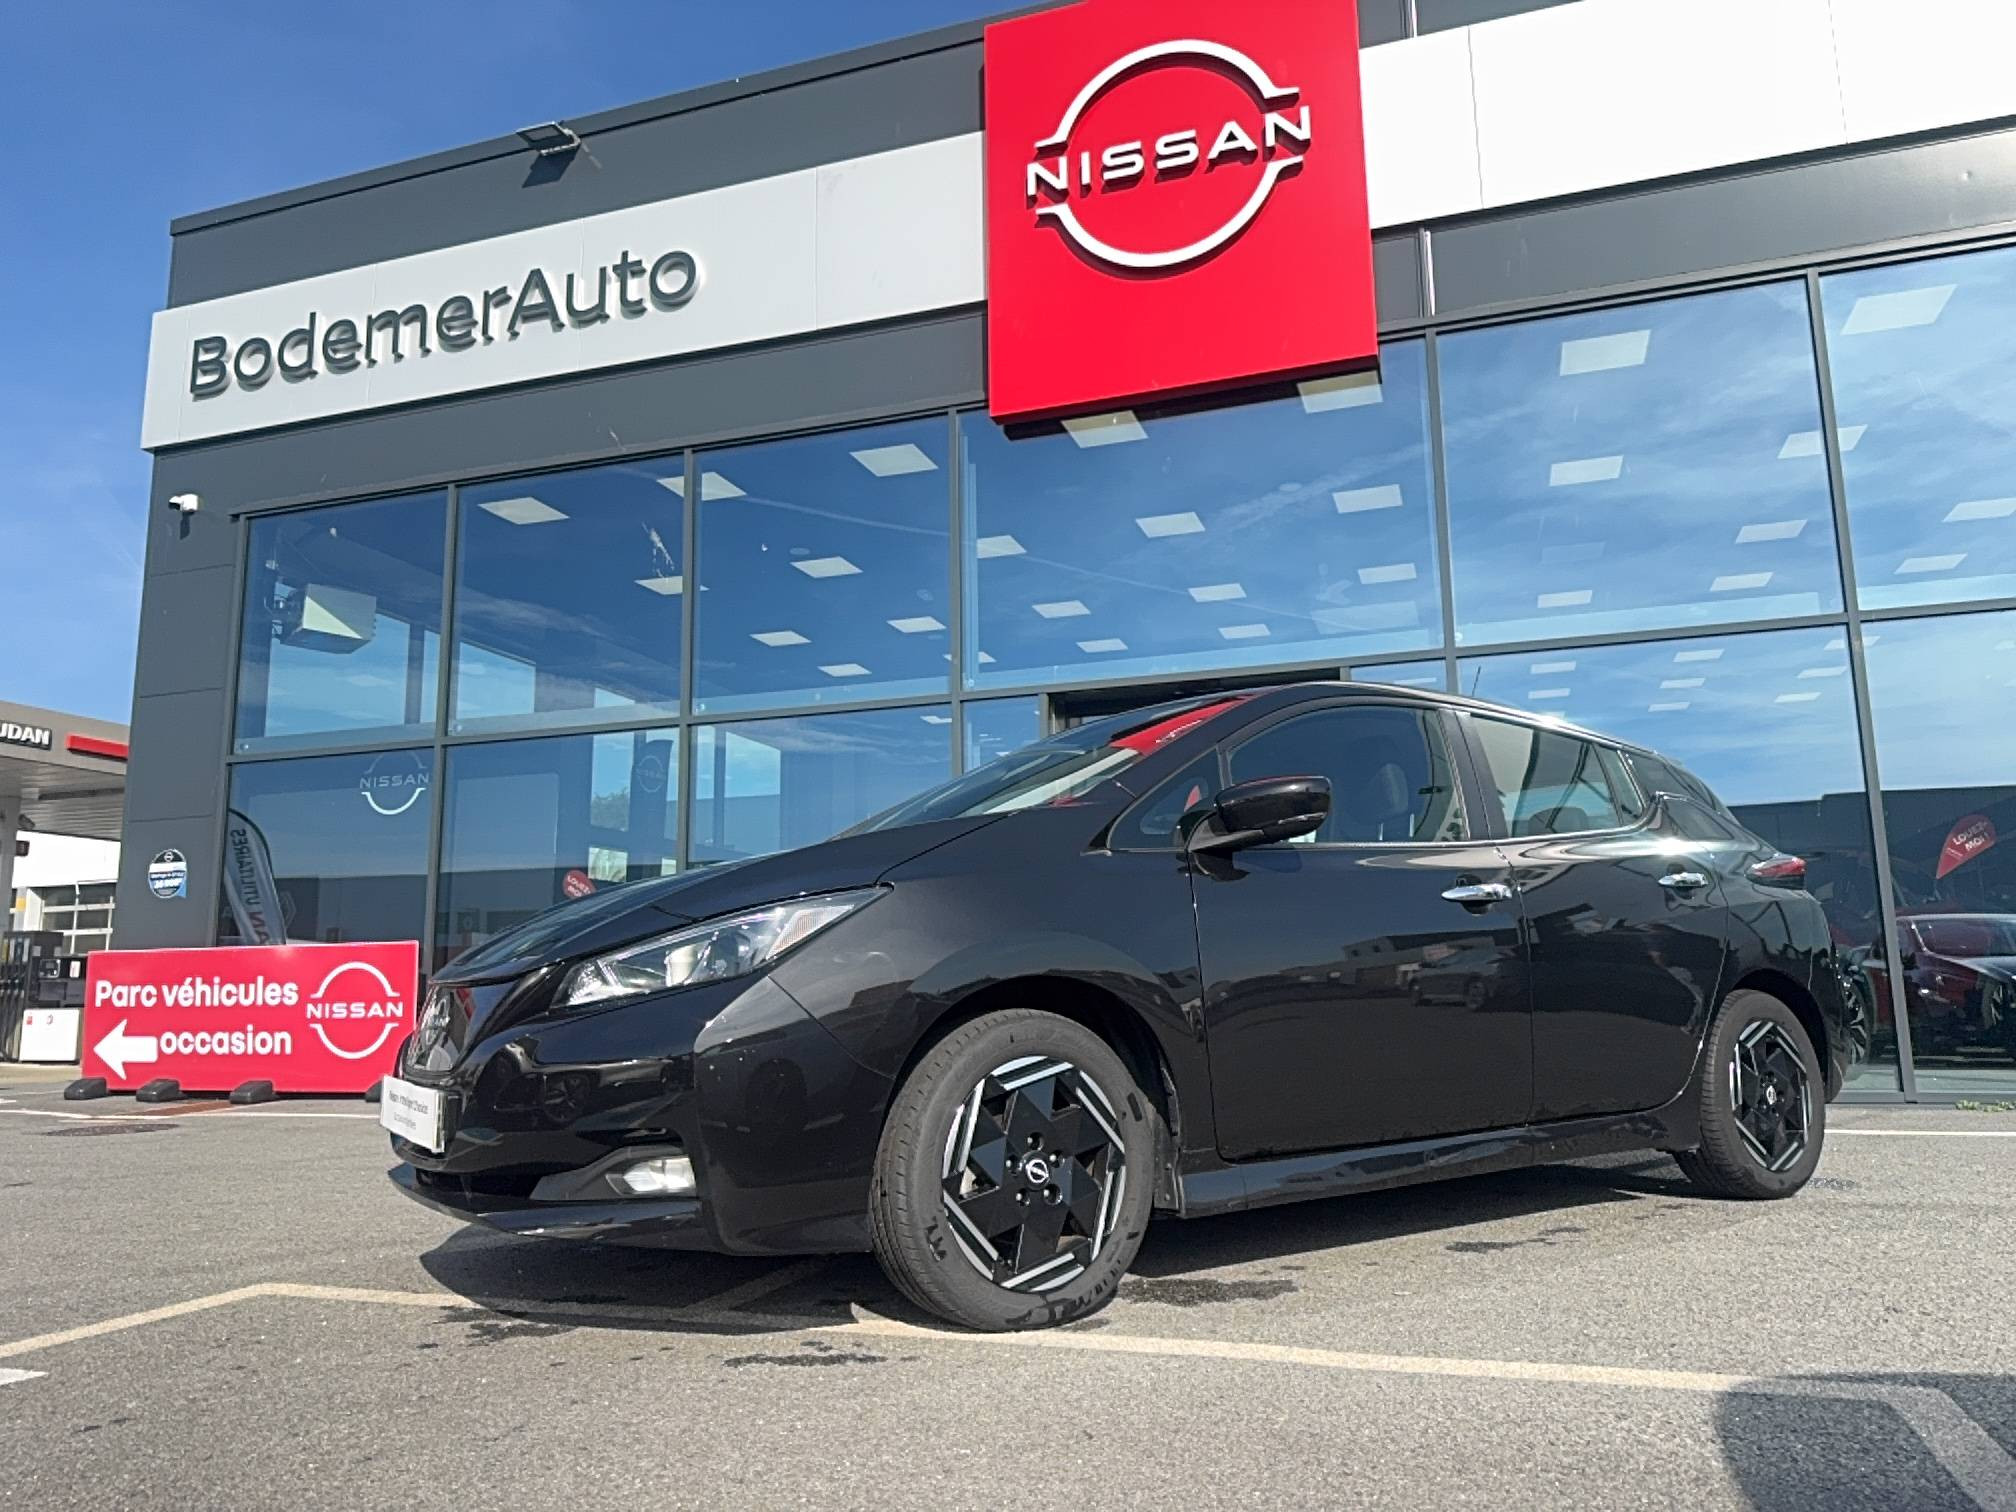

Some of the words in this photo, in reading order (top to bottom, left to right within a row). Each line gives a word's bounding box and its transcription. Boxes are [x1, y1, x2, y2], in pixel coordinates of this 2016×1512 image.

[1026, 105, 1311, 198] NISSAN
[189, 250, 702, 398] BodemerAuto
[359, 772, 430, 789] NISSAN
[95, 980, 157, 1007] Parc
[162, 976, 299, 1007] véhicules
[306, 1002, 404, 1019] NISSAN
[160, 1024, 292, 1055] occasion
